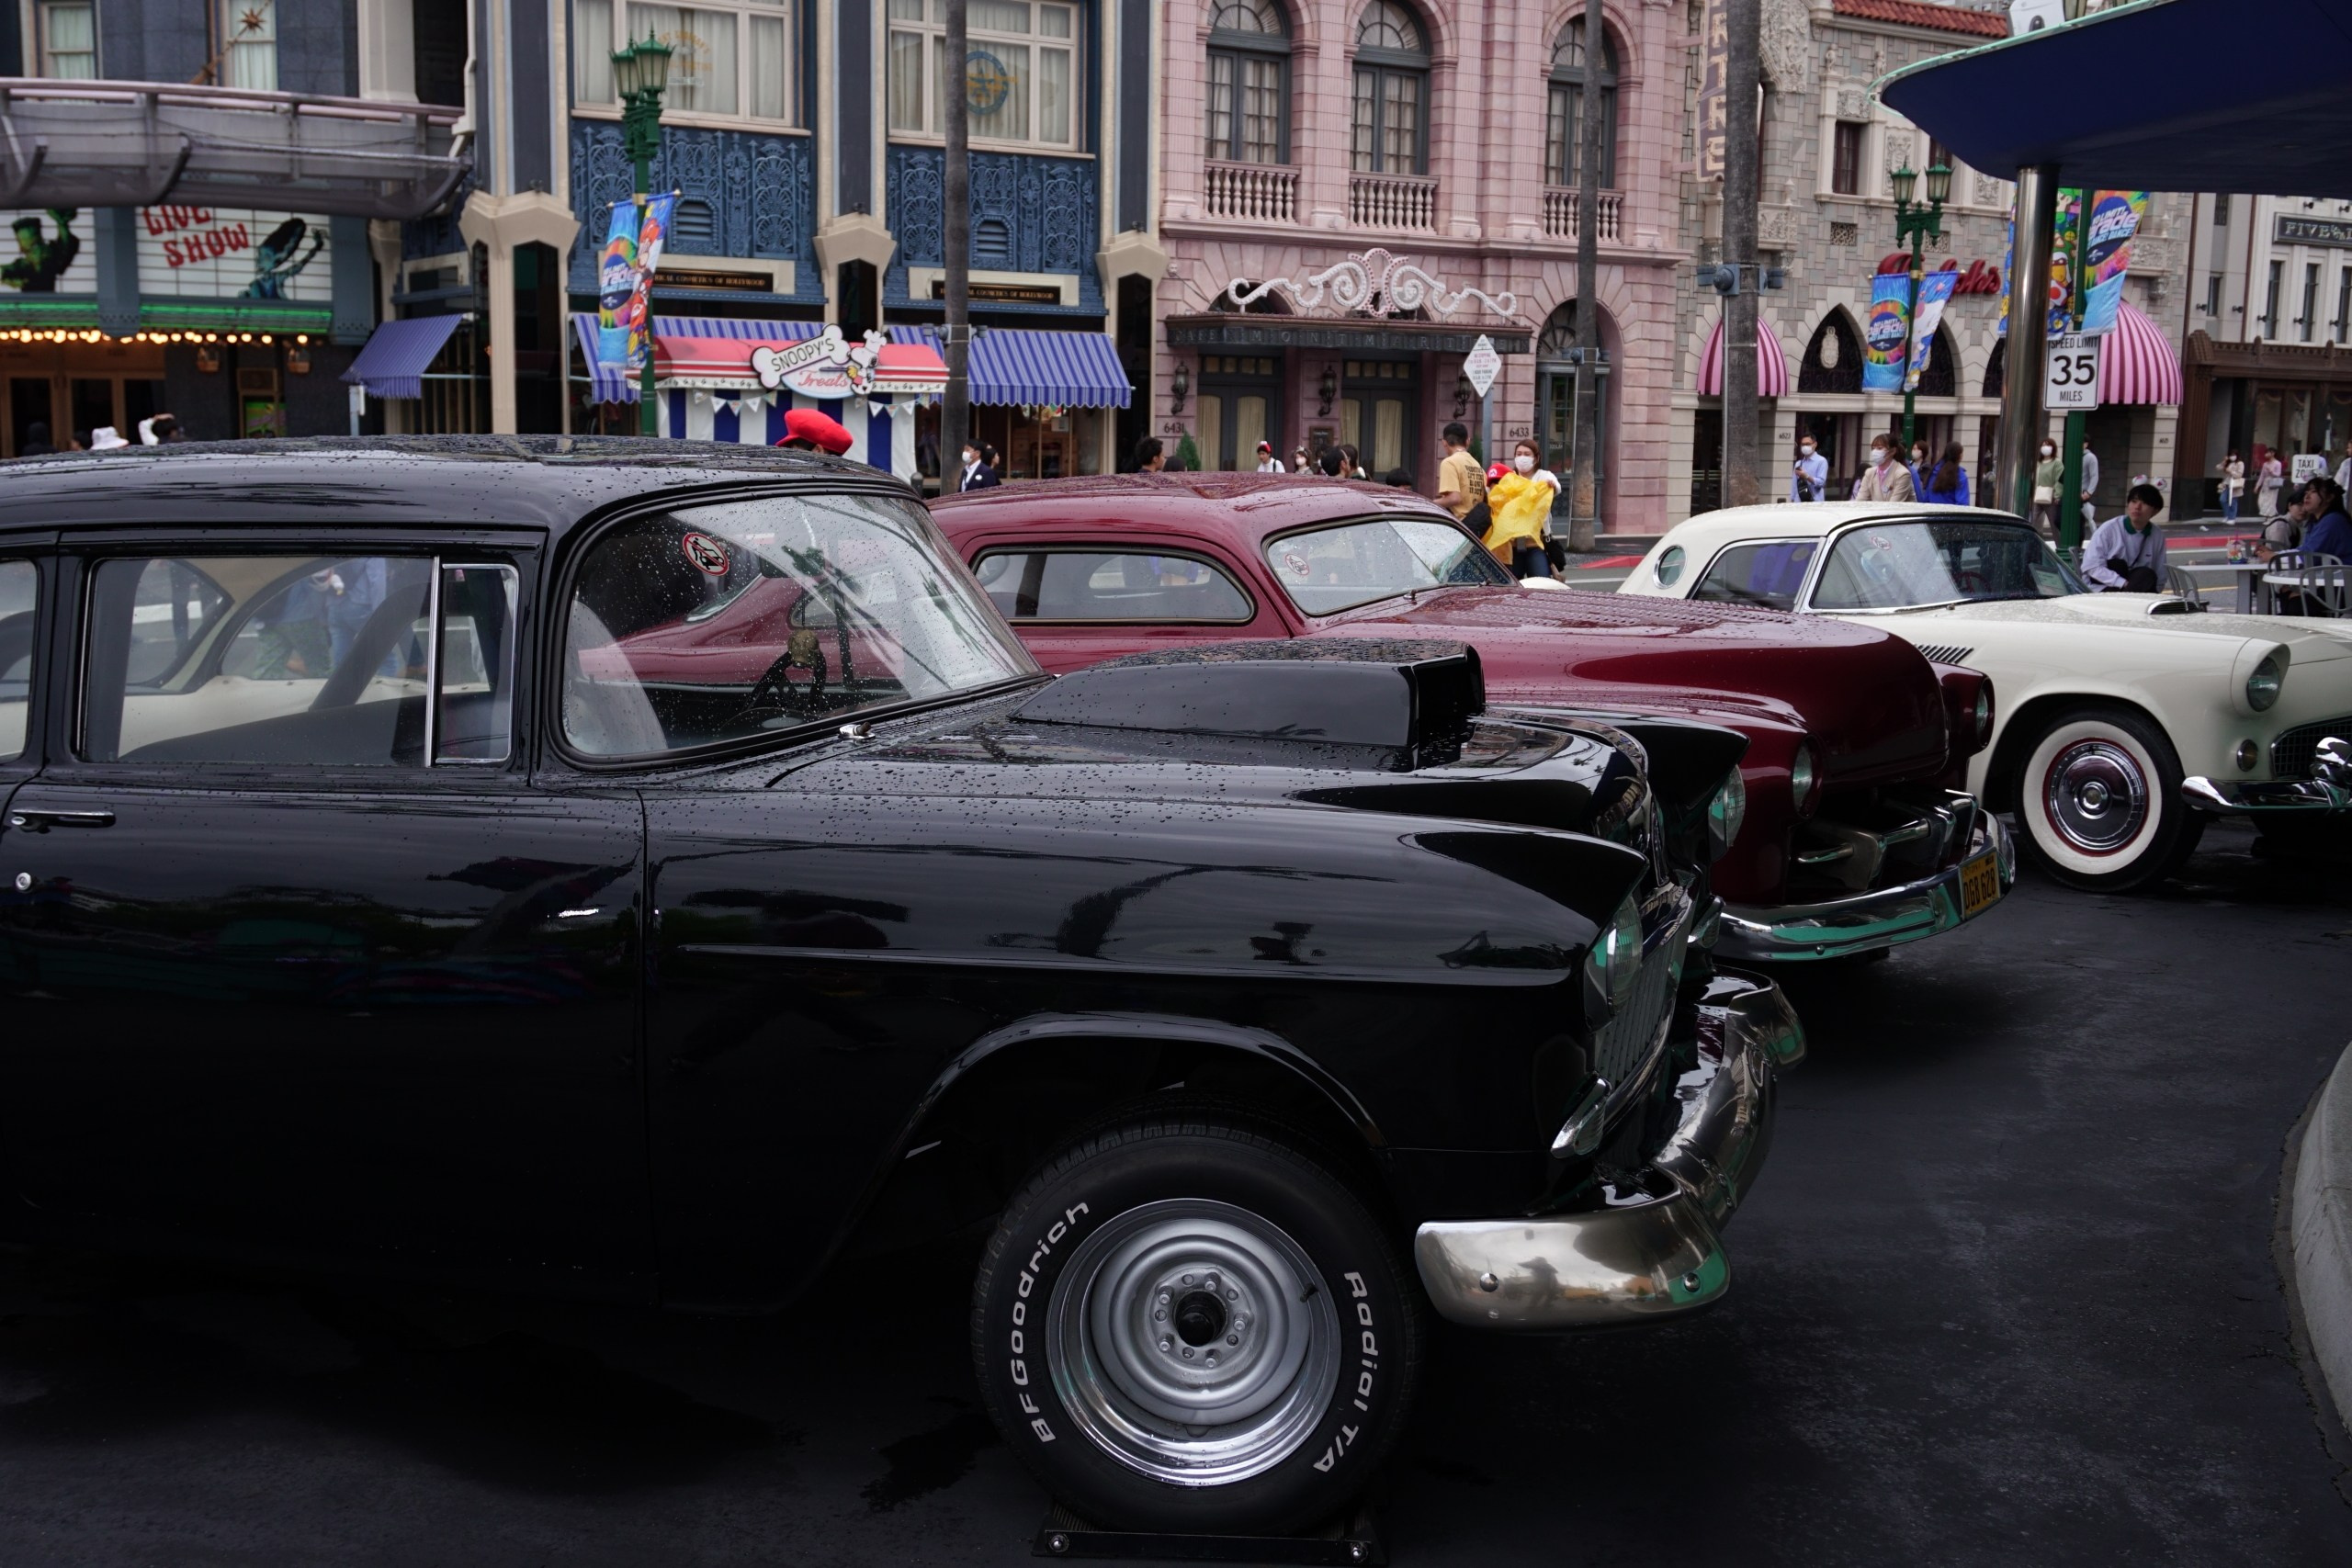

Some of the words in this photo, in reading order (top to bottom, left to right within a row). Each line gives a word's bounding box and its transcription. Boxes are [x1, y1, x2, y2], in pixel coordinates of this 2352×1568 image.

[142, 205, 211, 236] LIVE
[2089, 211, 2141, 237] arade
[2285, 221, 2331, 238] FIVE
[164, 222, 249, 268] SHOW
[726, 276, 765, 286] HOLLYWOOD
[1251, 329, 1507, 351] MONTMARTE
[2051, 337, 2075, 349] SPEED
[2076, 336, 2098, 348] LIMIT
[772, 337, 835, 372] SNOOPY'S
[797, 369, 849, 387] Treats
[2051, 355, 2096, 385] 35
[2059, 390, 2083, 401] MILES
[1164, 422, 1184, 434] 6431
[1510, 427, 1530, 438] 6433
[2298, 459, 2314, 468] TAXI
[1010, 1201, 1090, 1443] BFGoodrich
[1343, 1270, 1379, 1412] Radial
[1312, 1424, 1361, 1473] T/A
